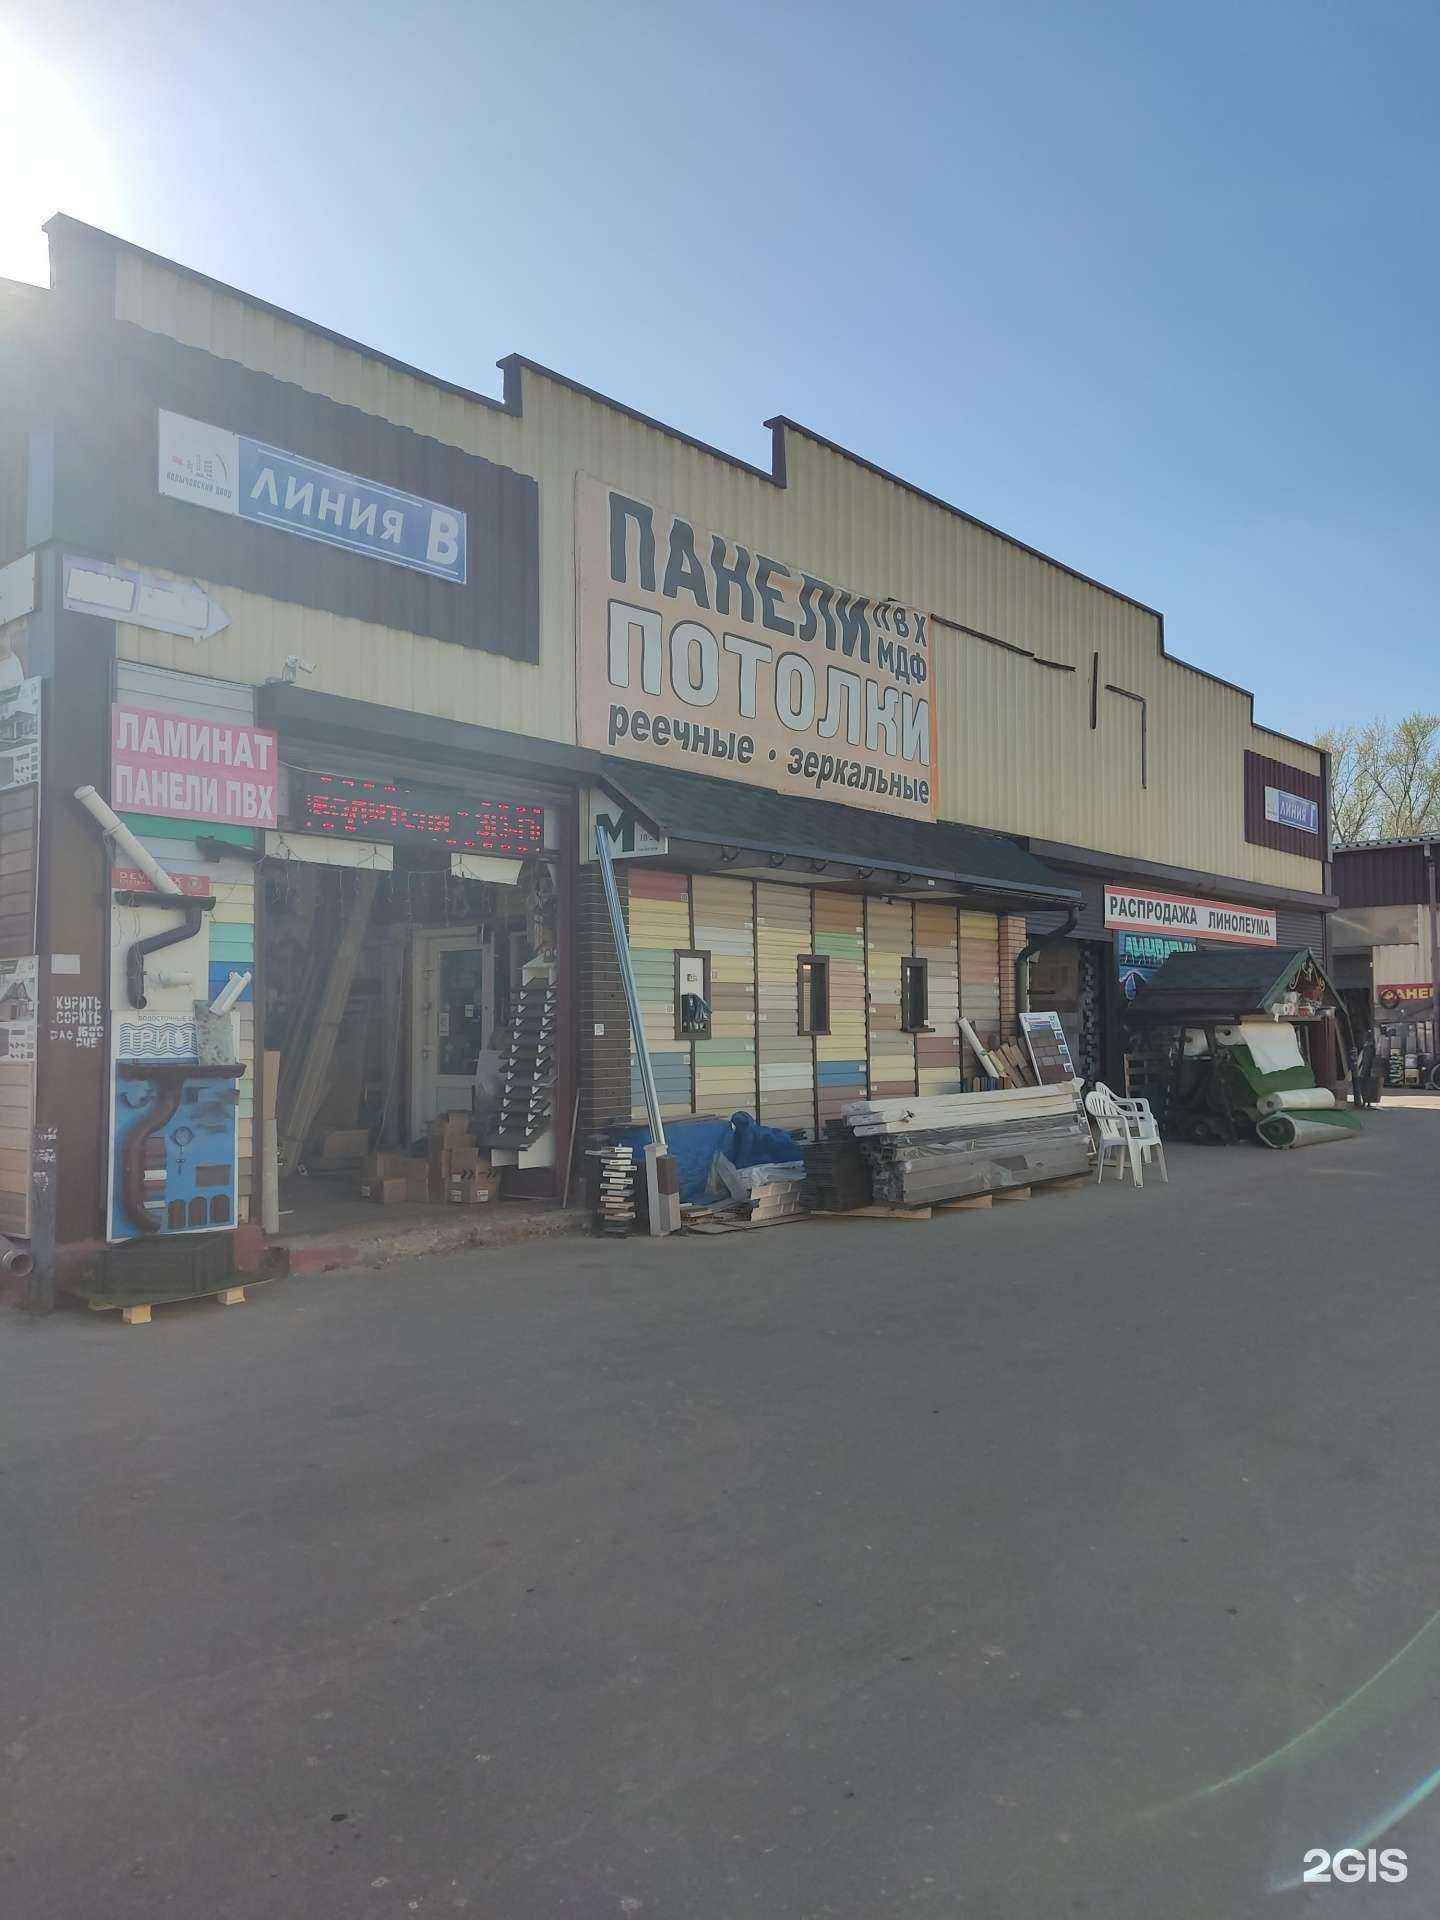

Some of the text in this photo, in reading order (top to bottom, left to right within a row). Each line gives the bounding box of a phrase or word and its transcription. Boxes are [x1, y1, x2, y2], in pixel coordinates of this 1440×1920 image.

[250, 467, 459, 565] ЛИНИЯ В
[608, 491, 871, 663] ПАНЕЛИ
[607, 598, 930, 766] ПОТОЛКИ
[877, 637, 927, 685] МДФ
[116, 711, 273, 770] ЛАМИНАТ
[608, 703, 930, 804] реечные зеркальные
[116, 764, 217, 815] ПАНЕЛИ
[225, 781, 273, 820] ПВХ
[1110, 896, 1271, 936] РАСПРОДАЖА ЛИНОЛЕУМА
